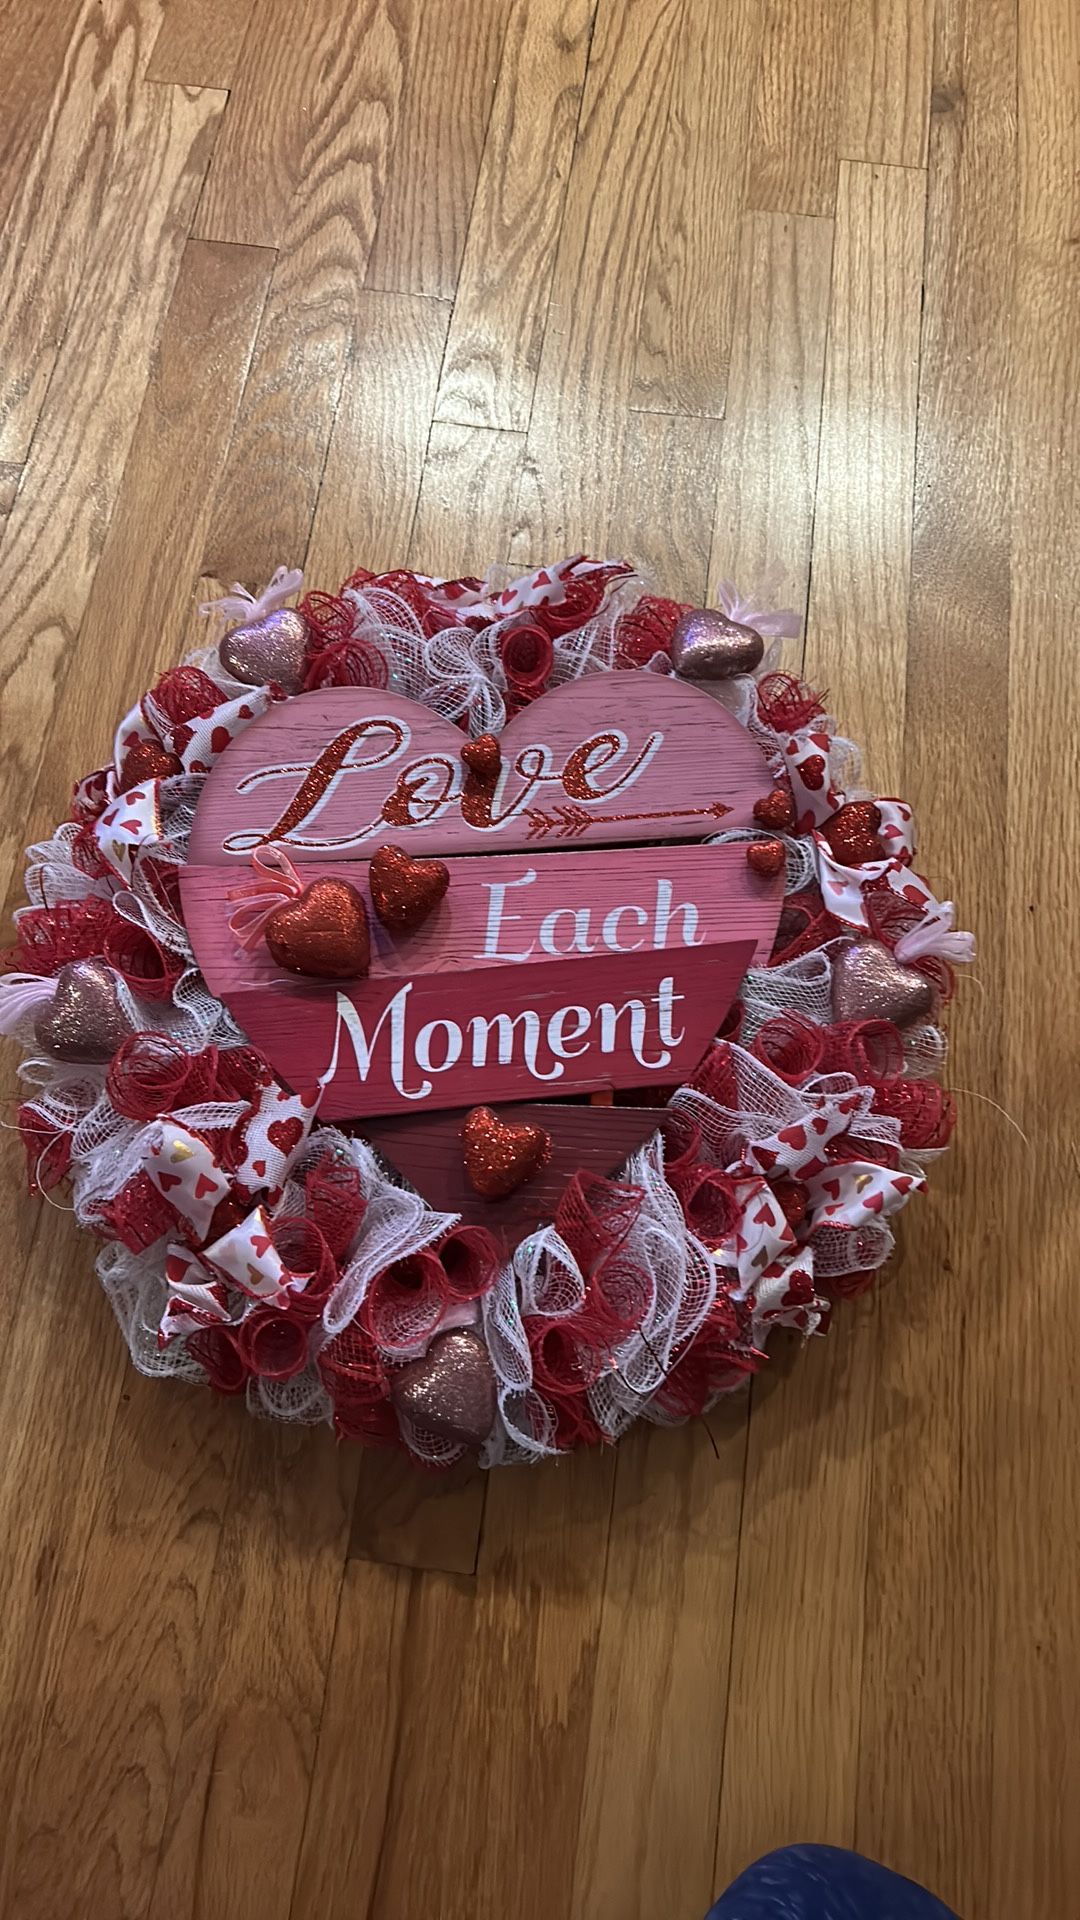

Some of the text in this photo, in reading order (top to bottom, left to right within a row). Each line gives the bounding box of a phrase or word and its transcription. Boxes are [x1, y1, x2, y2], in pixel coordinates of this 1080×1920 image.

[222, 714, 664, 856] Love
[473, 868, 705, 961] Each
[320, 977, 686, 1100] Moment
